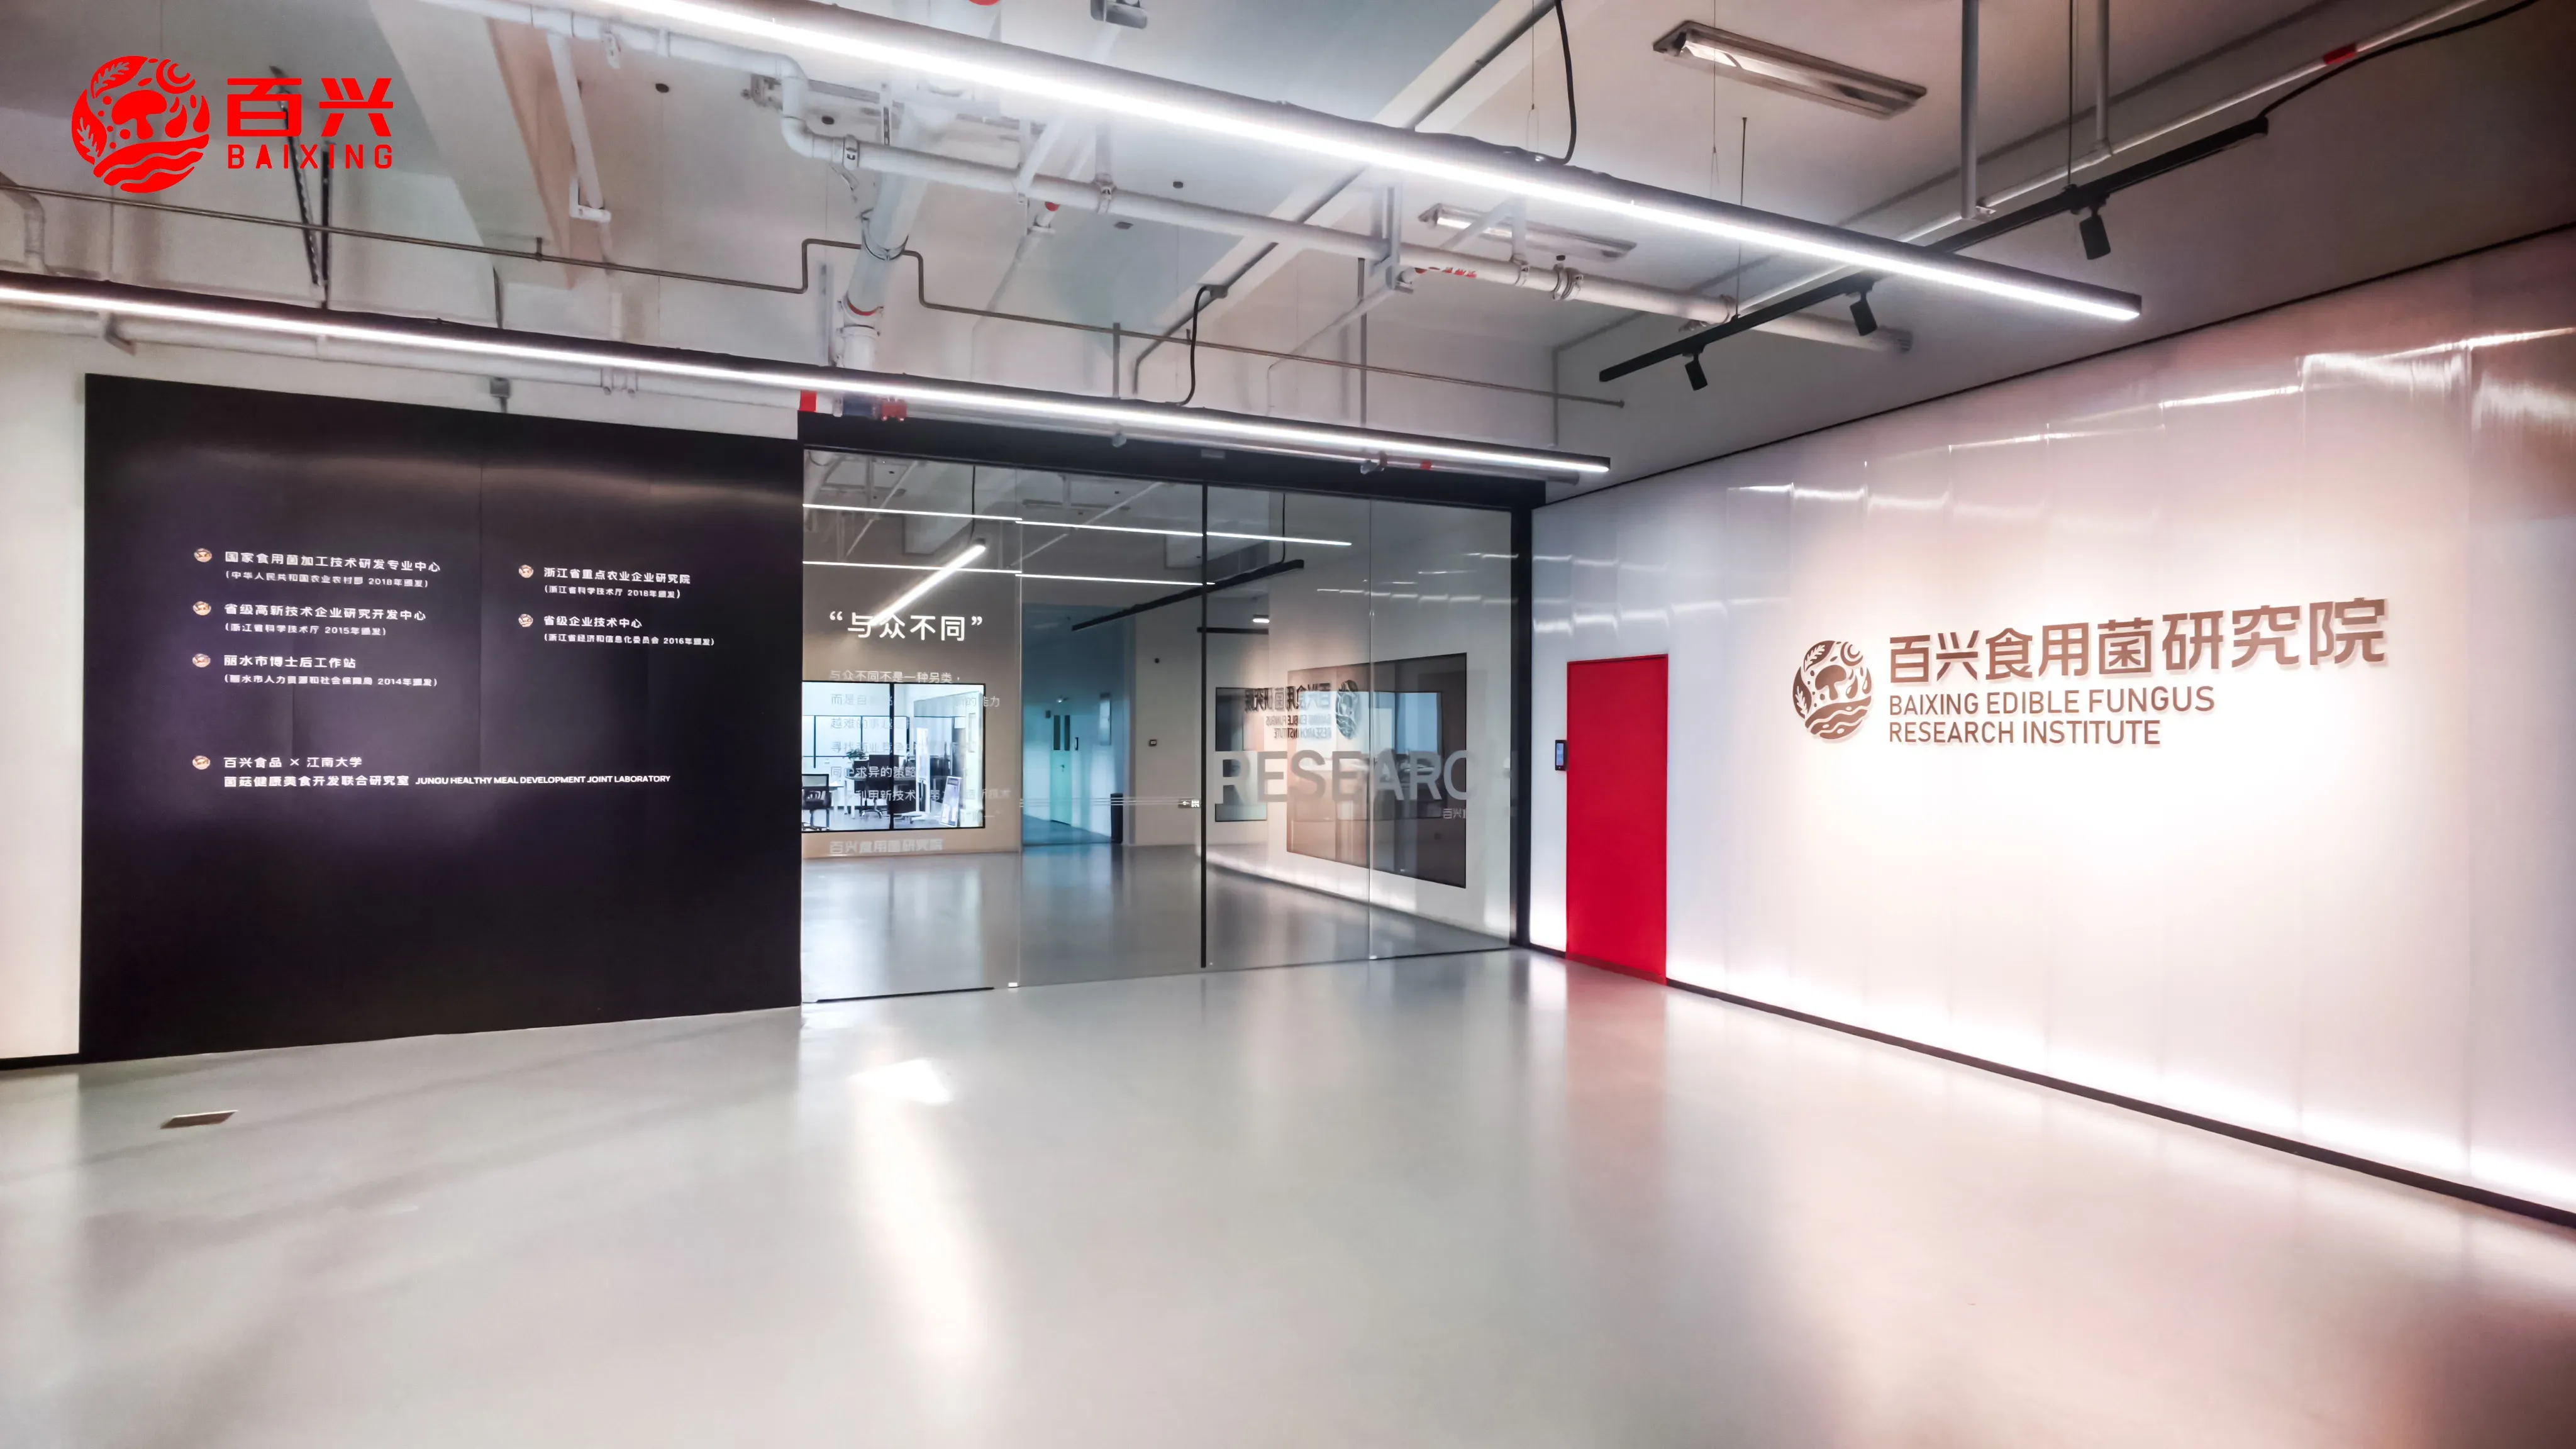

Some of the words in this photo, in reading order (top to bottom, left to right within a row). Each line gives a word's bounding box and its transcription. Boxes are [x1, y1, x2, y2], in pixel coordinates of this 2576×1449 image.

[225, 551, 441, 574] 国家食用菌加工技术研发专业中心
[543, 567, 691, 584] 浙江省重点农业企业研究院
[224, 603, 426, 621] 省级高新技术企业研究开发中心
[544, 615, 643, 628] 省级企业技术中心
[1889, 597, 2387, 684] 百兴食用菌研究院
[224, 655, 356, 669] 丽水市博士后工作站
[1890, 693, 1979, 716] BAIXING
[1987, 691, 2080, 714] EDIBLE
[2089, 686, 2215, 713] FUNGUS
[1889, 721, 2013, 743] RESEARCH
[2023, 719, 2161, 745] INSTITUTE
[224, 757, 282, 768] 百兴食品
[306, 757, 362, 768] 江南大学
